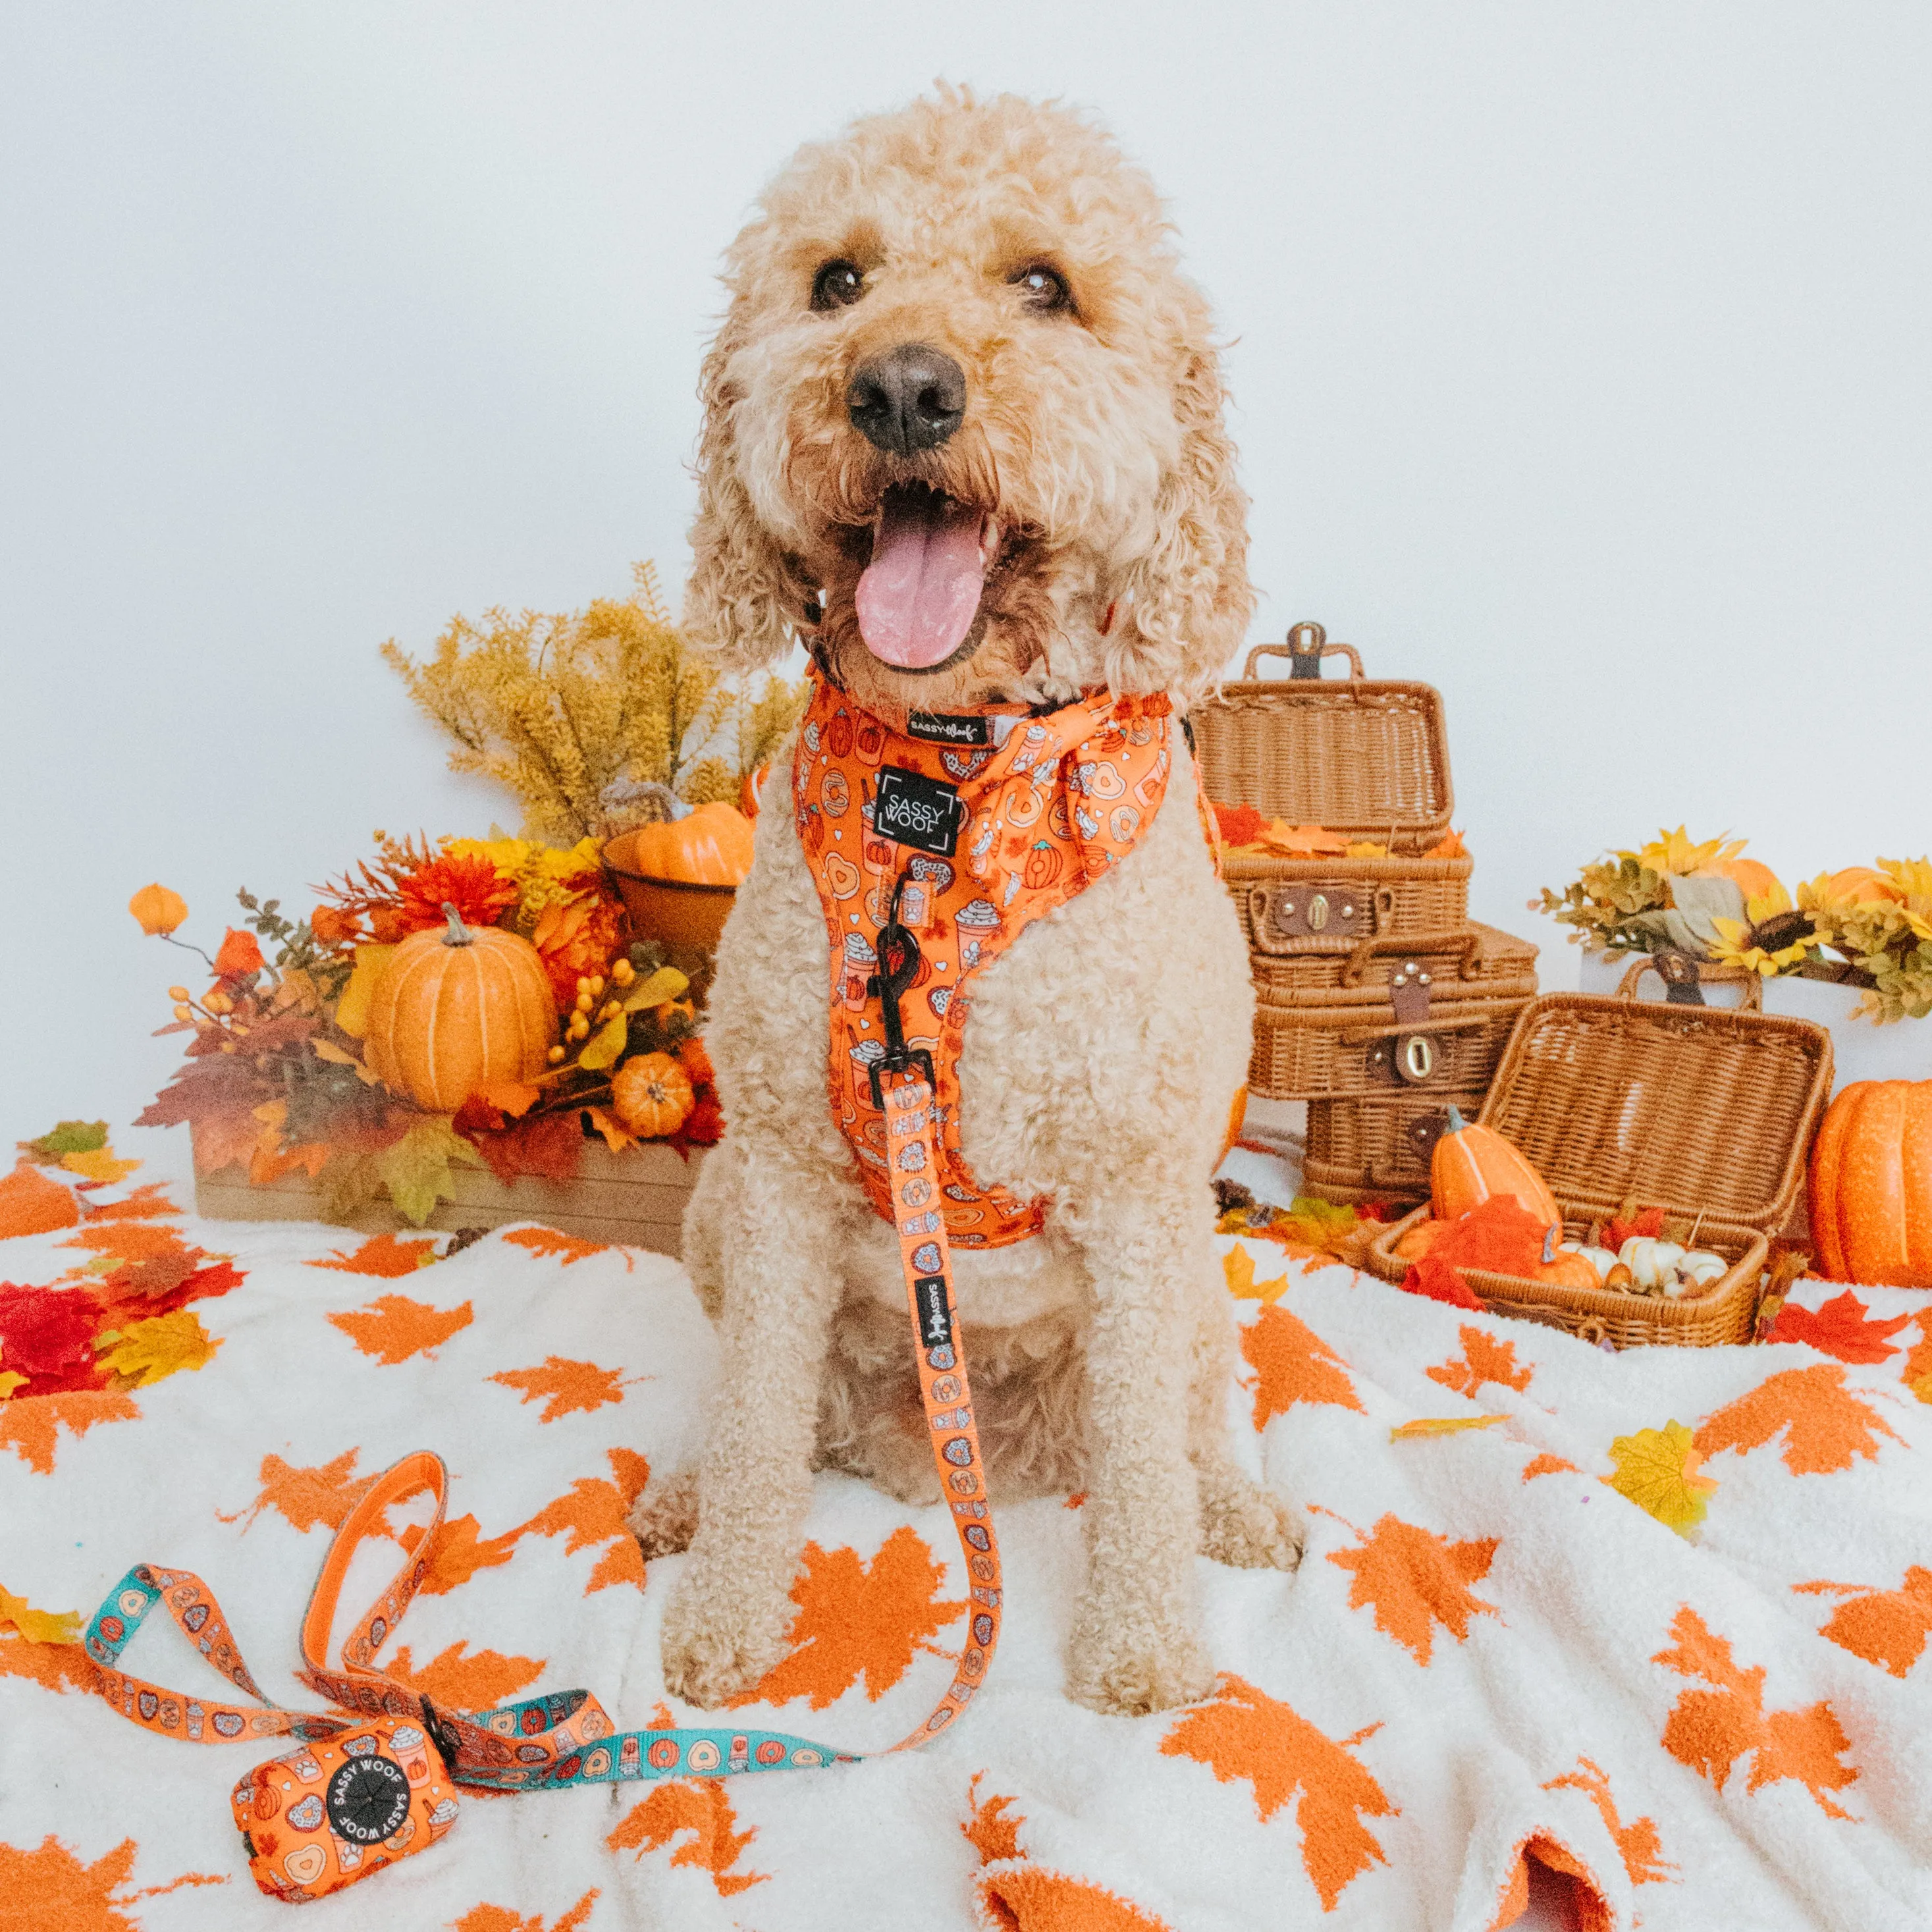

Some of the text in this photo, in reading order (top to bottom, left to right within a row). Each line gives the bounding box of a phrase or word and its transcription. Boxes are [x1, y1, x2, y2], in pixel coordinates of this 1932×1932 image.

[911, 720, 944, 734] SASSY
[885, 805, 939, 833] WOOF
[888, 793, 945, 822] SASSY
[928, 1283, 941, 1316] SASSY
[334, 1759, 403, 1806] SASSY WOOF
[338, 1792, 407, 1840] SASSY WOOF
